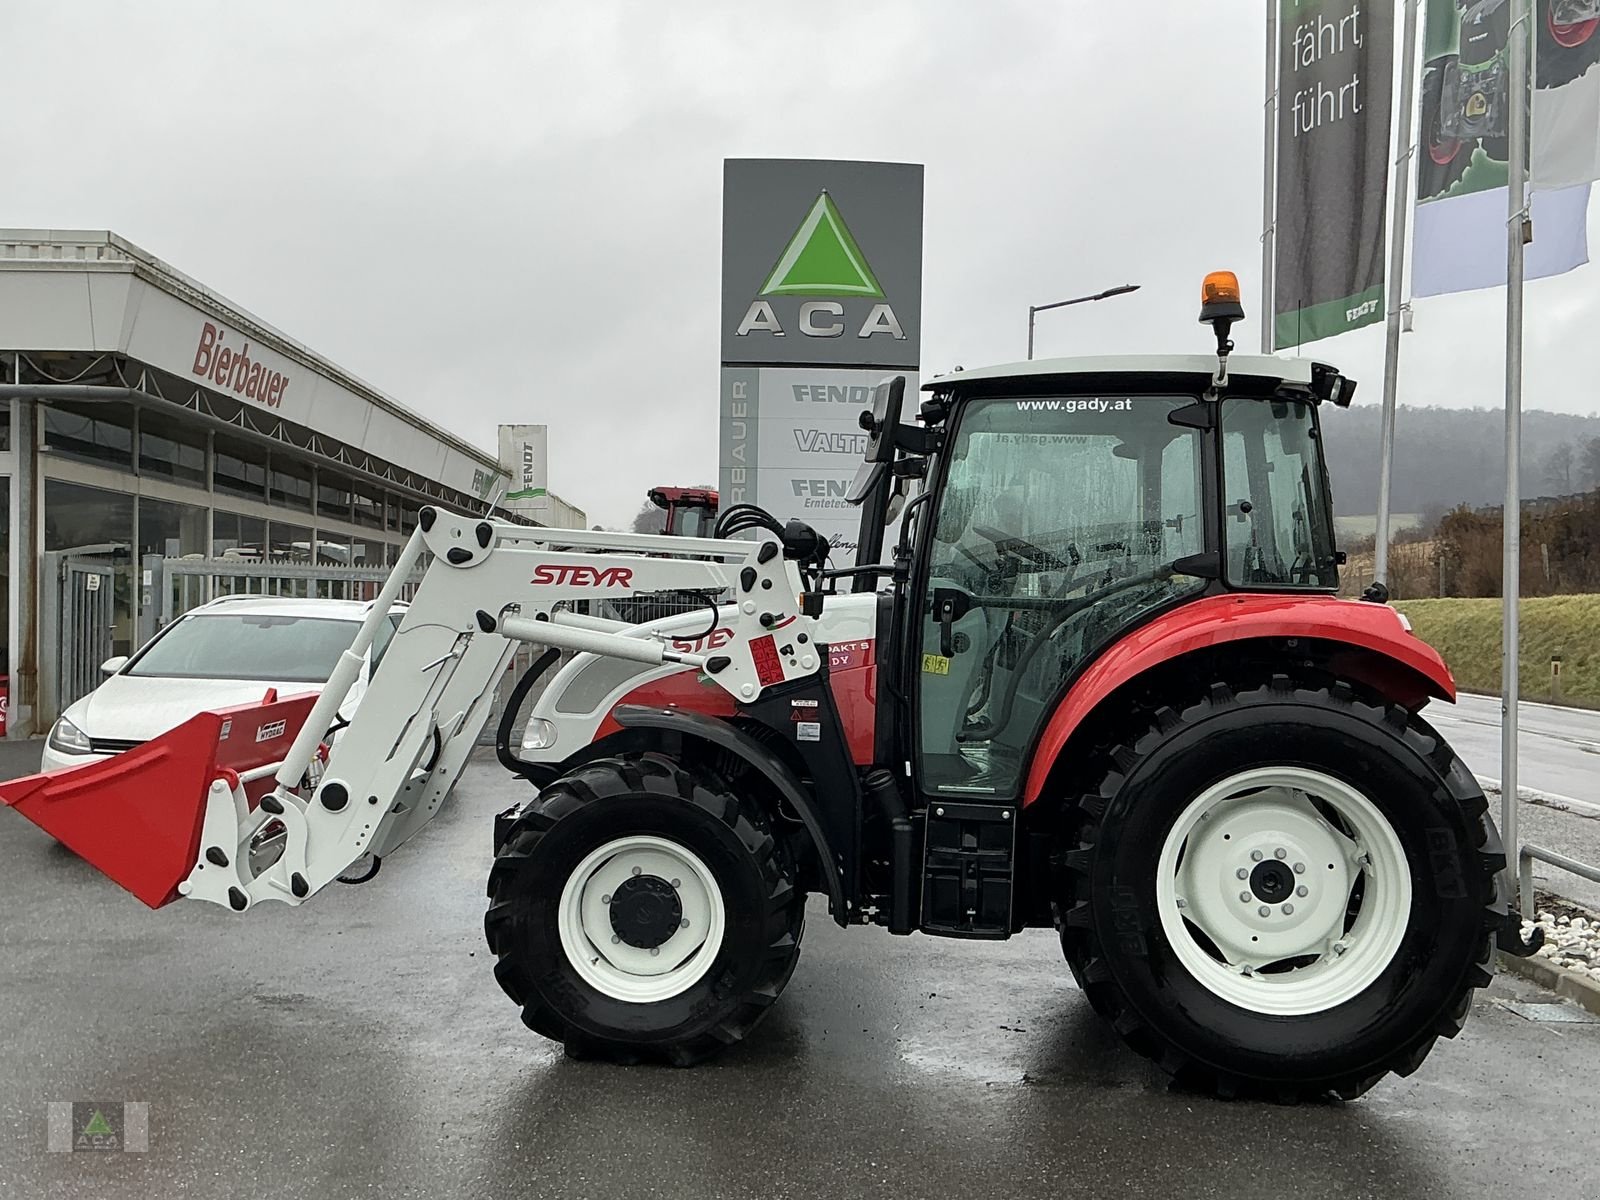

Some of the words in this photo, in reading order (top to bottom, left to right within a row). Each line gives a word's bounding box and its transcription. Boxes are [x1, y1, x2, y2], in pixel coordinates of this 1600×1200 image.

[1292, 5, 1363, 71] fährt,
[1291, 73, 1362, 137] führt.
[735, 300, 907, 340] ACA
[192, 321, 290, 409] Bierbauer
[1016, 398, 1132, 413] www.gady.at
[793, 428, 870, 455] VALTR
[523, 442, 533, 492] FENDT
[791, 480, 853, 497] FEN
[804, 498, 863, 509] Erntetec
[530, 564, 633, 588] STEYR
[672, 628, 736, 653] STE
